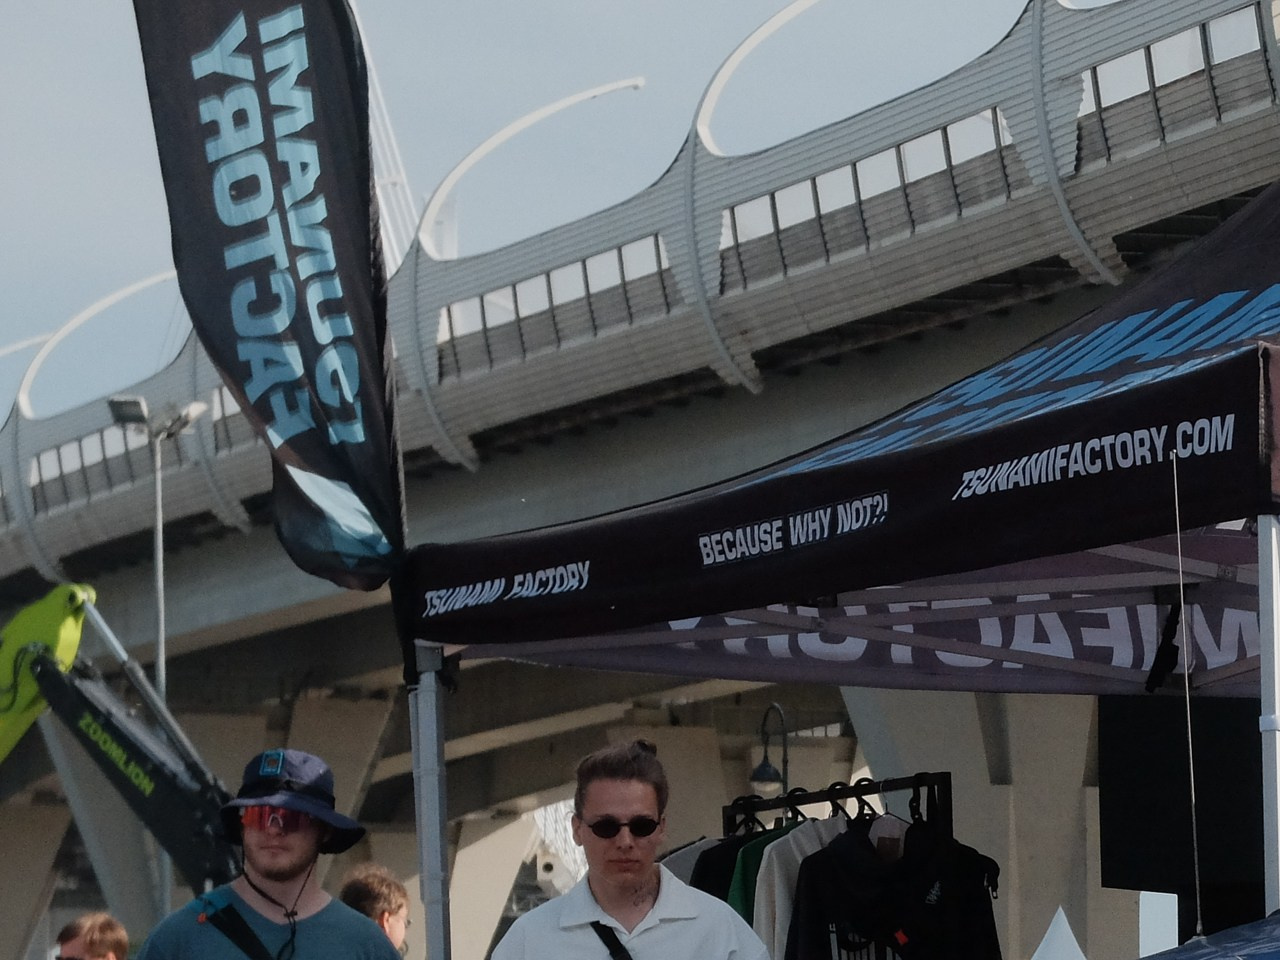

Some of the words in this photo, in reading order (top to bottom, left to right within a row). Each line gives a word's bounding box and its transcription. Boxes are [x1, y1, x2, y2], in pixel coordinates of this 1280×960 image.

[952, 413, 1236, 501] TSUNAMIFACTORY.COM
[699, 519, 783, 566] BECAUSE
[789, 507, 832, 546] WHY
[837, 493, 888, 535] NOT?!
[422, 577, 506, 618] TSUNAMI
[503, 560, 590, 601] FACTORY
